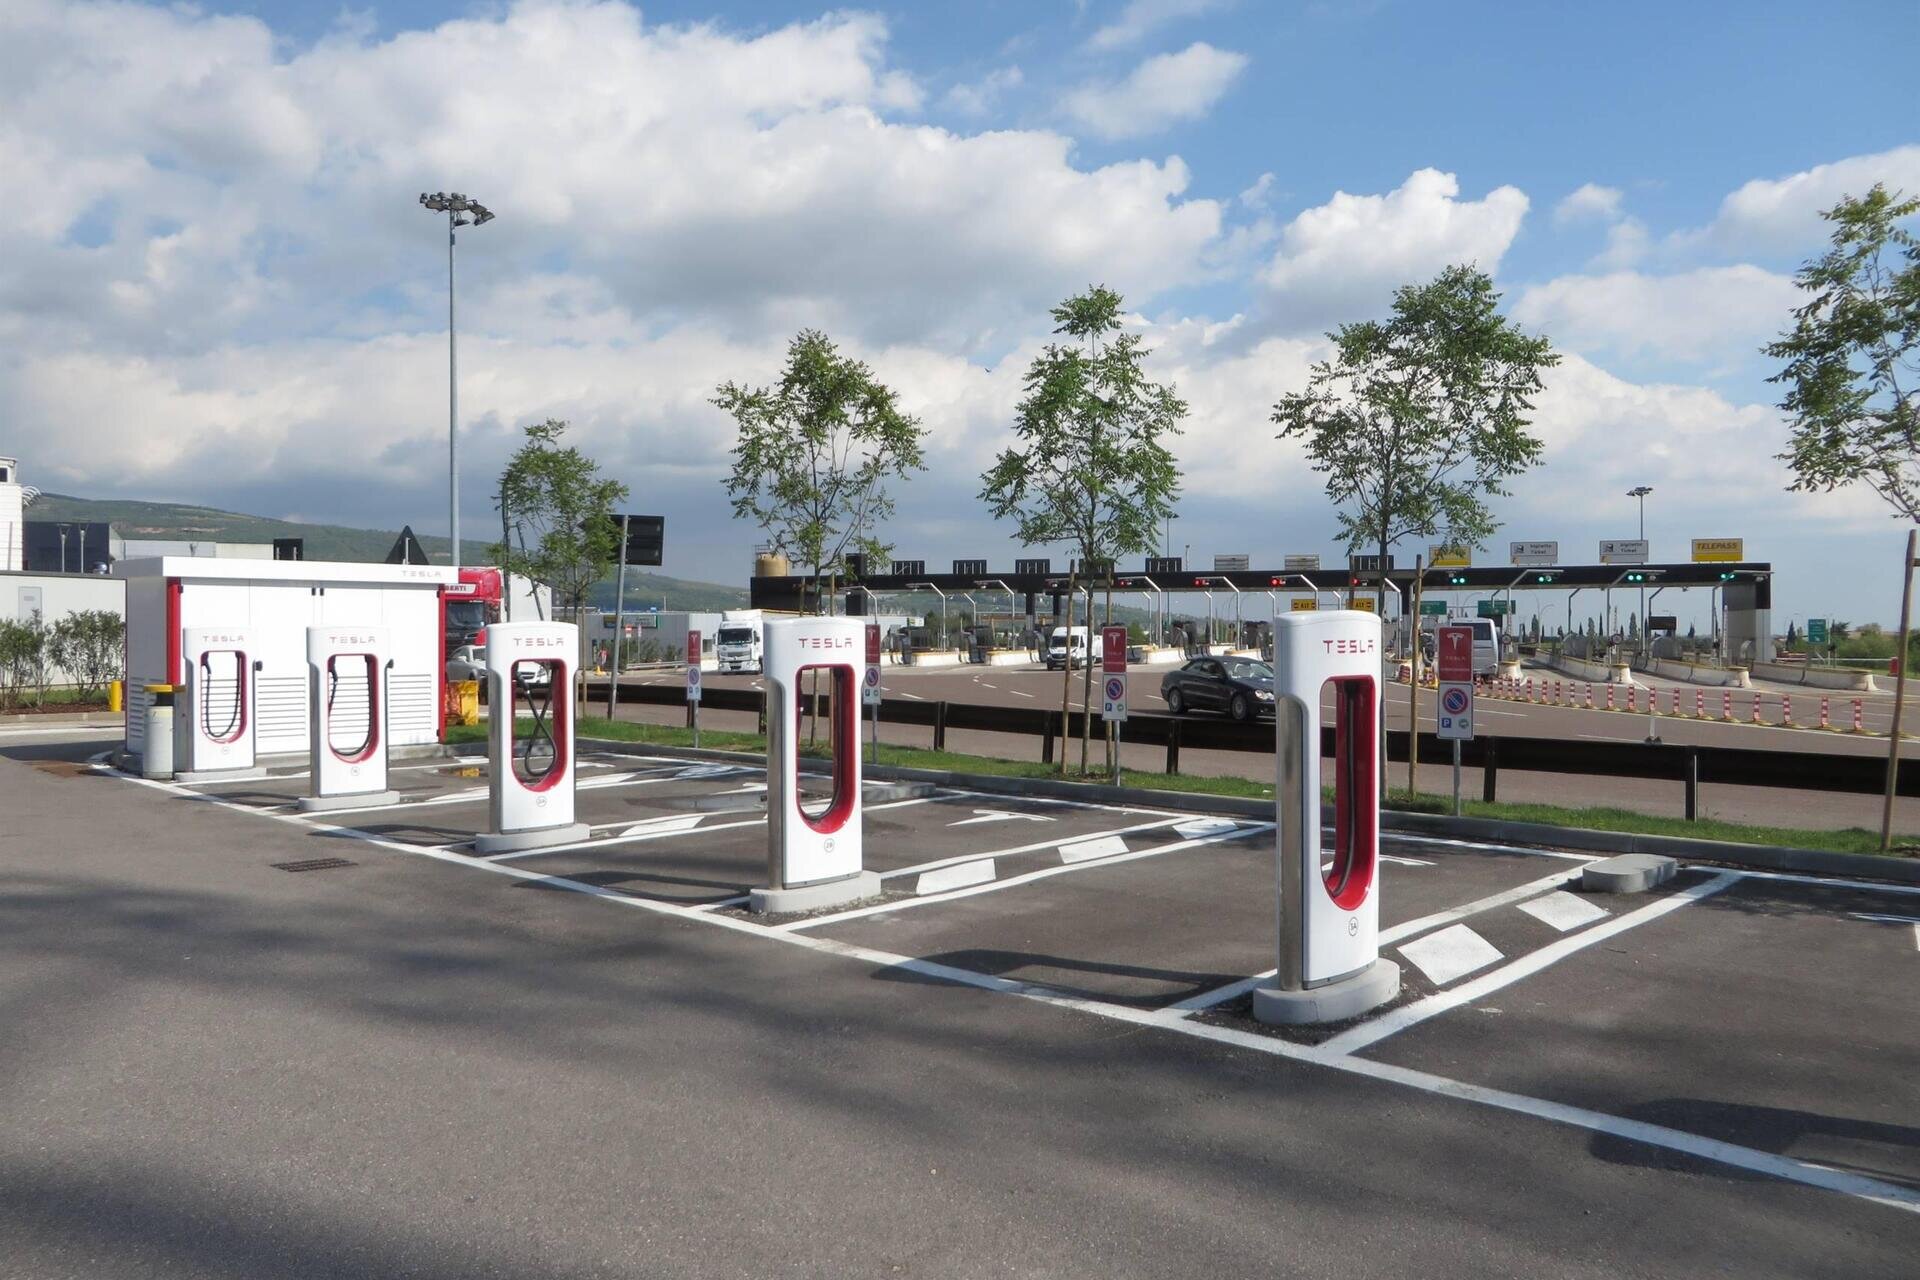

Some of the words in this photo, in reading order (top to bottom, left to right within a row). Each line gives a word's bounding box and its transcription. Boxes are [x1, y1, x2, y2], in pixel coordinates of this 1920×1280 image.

[329, 636, 376, 644] TESLA
[513, 637, 564, 646] TESLA
[798, 638, 852, 648] TESLA
[1323, 640, 1373, 654] TESLA
